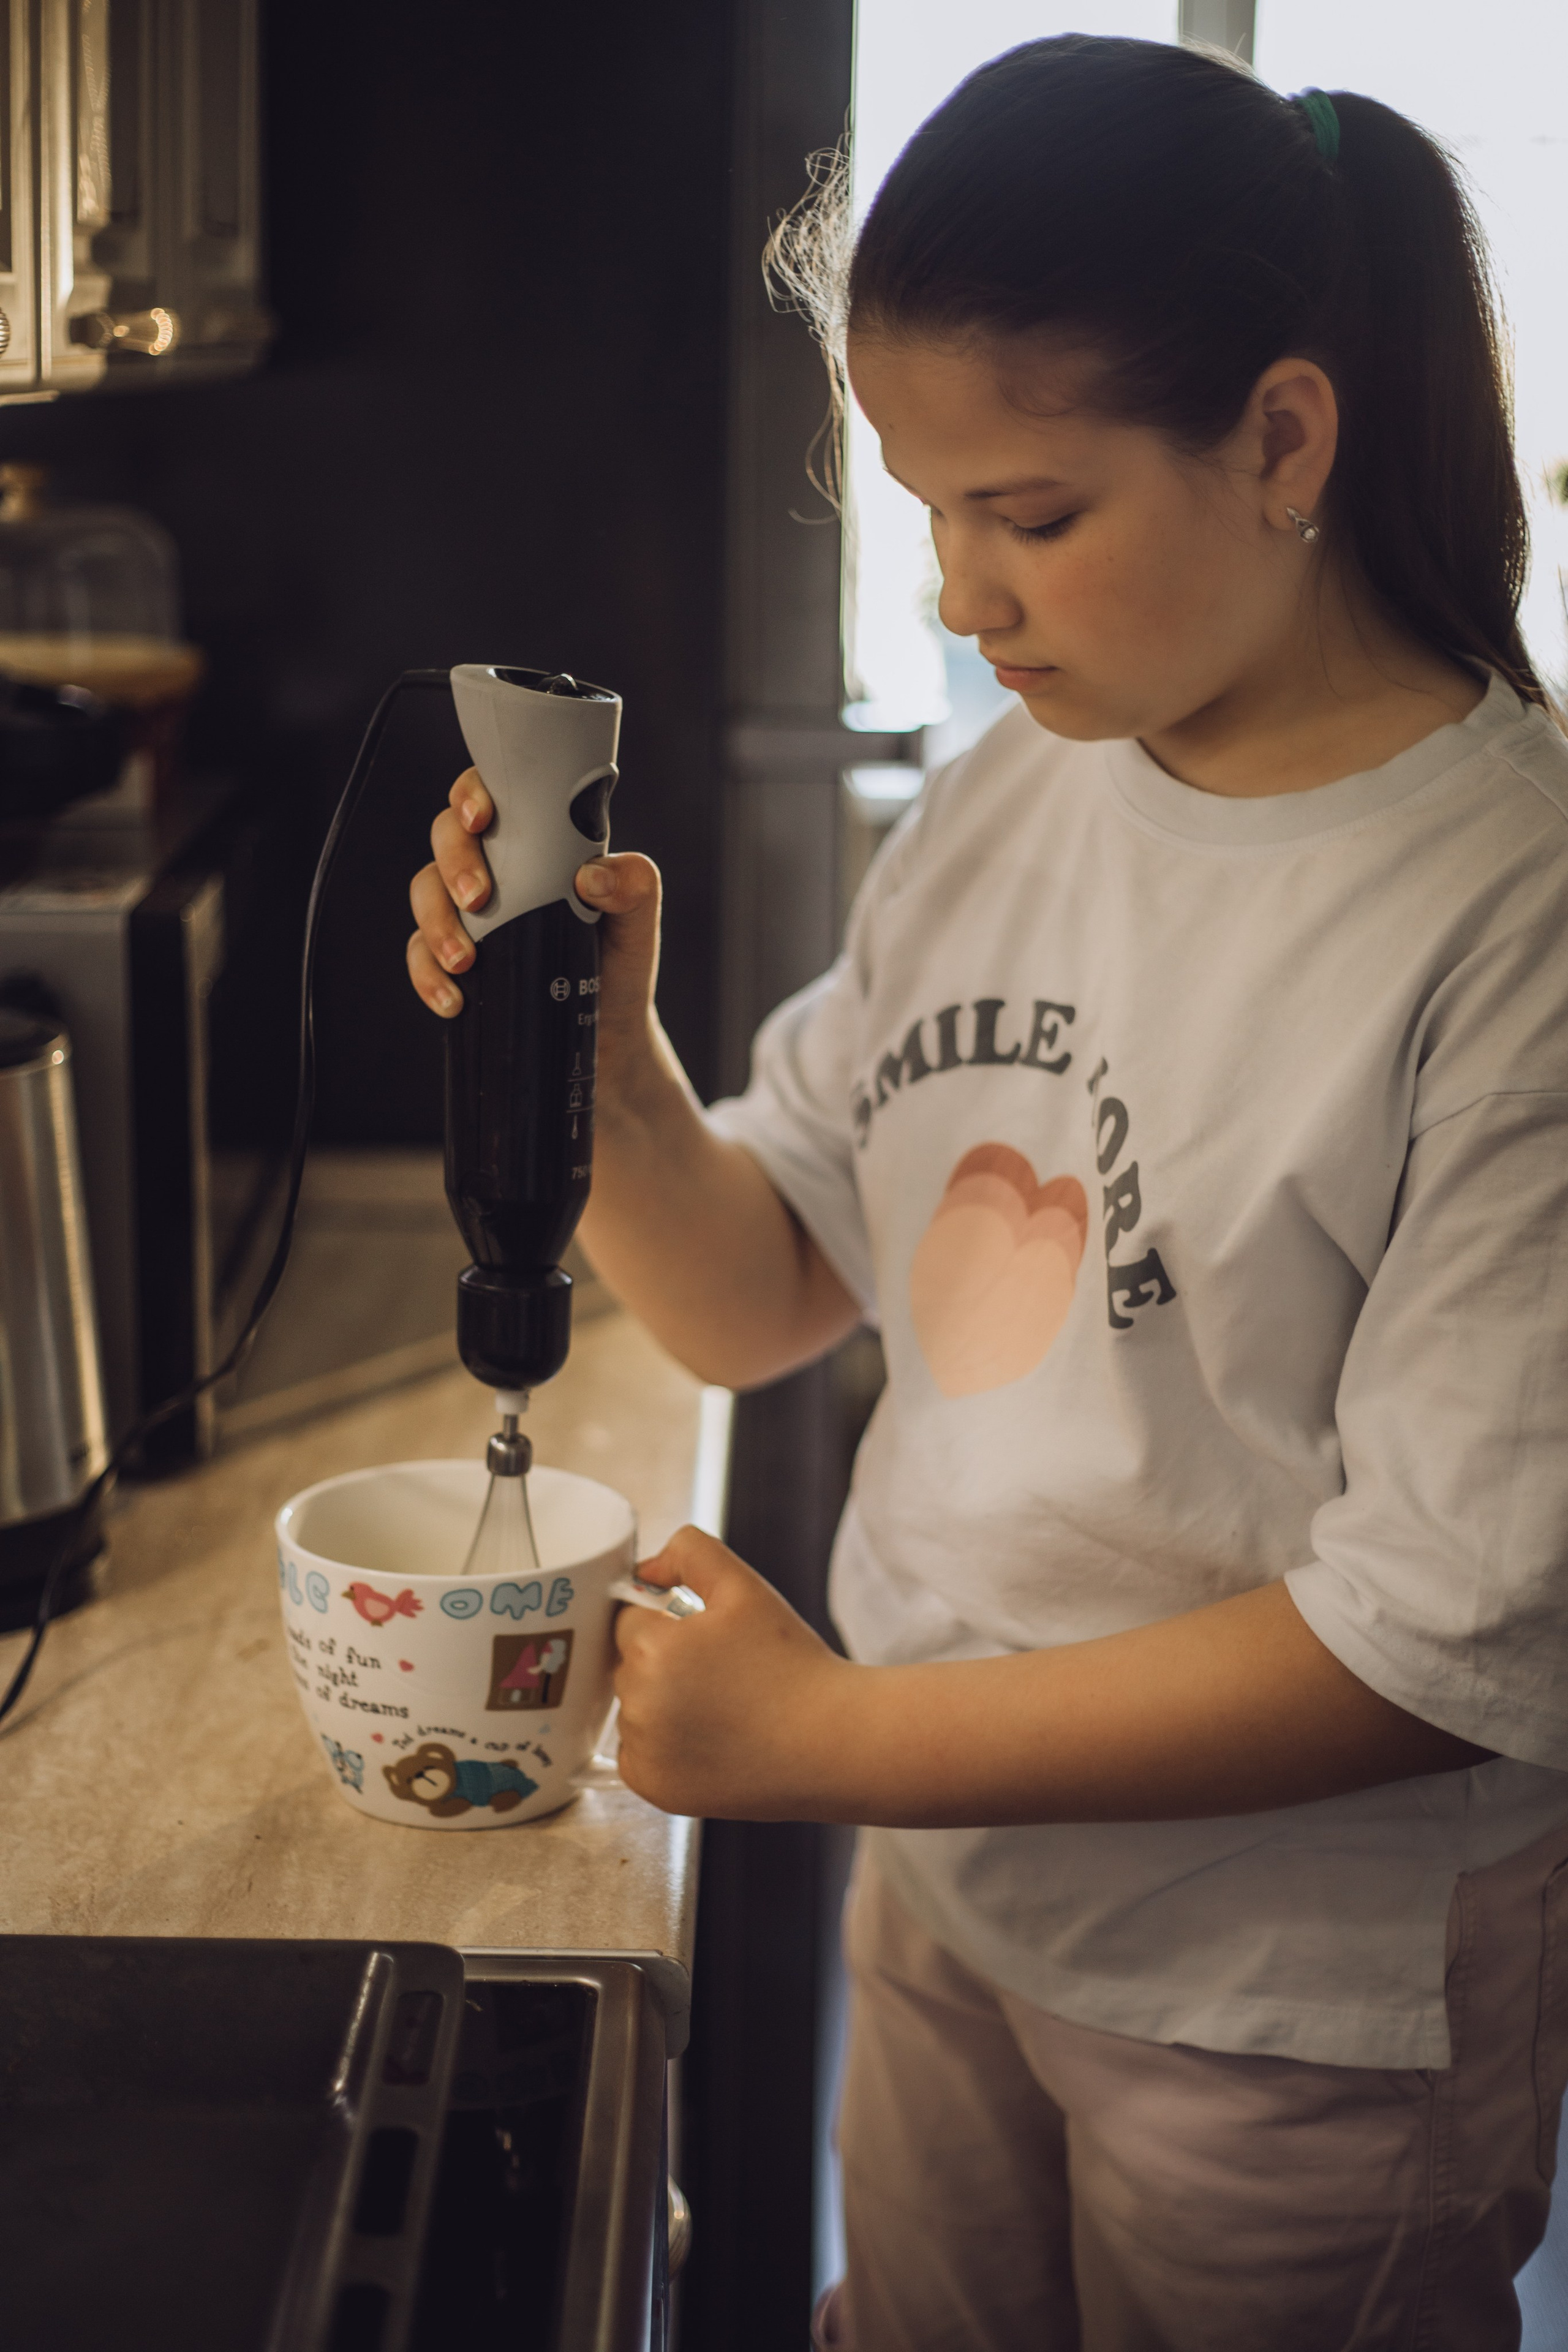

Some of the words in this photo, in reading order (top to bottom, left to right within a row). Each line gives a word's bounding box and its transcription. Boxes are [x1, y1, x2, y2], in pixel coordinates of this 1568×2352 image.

[439, 1577, 575, 1621] OME
[345, 1645, 382, 1670] fun
[315, 1662, 360, 1687] night
[337, 1691, 410, 1719] dreams
